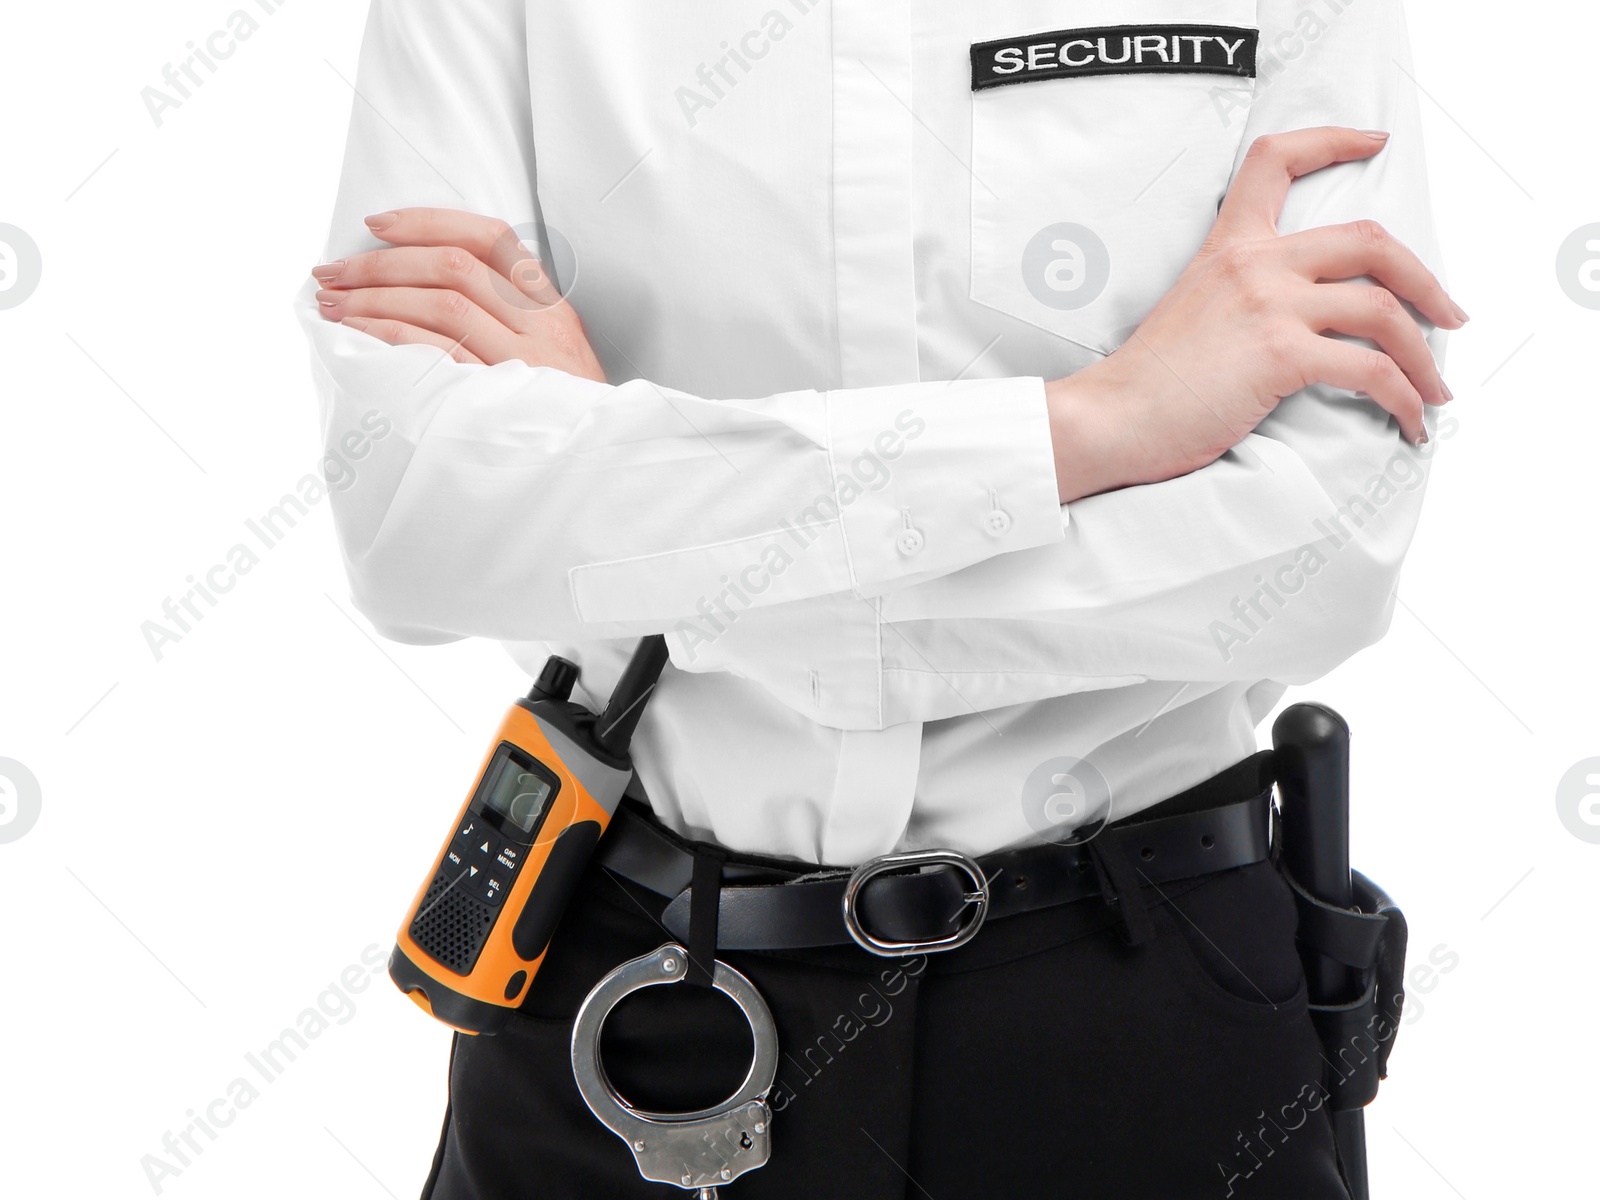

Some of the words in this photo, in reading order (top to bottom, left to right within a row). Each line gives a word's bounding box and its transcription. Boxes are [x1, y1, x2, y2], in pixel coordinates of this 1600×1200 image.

[992, 35, 1245, 74] SECURITY
[448, 851, 461, 865] MON
[503, 847, 517, 858] GRP
[496, 854, 515, 869] MENU
[488, 879, 500, 891] SEL
